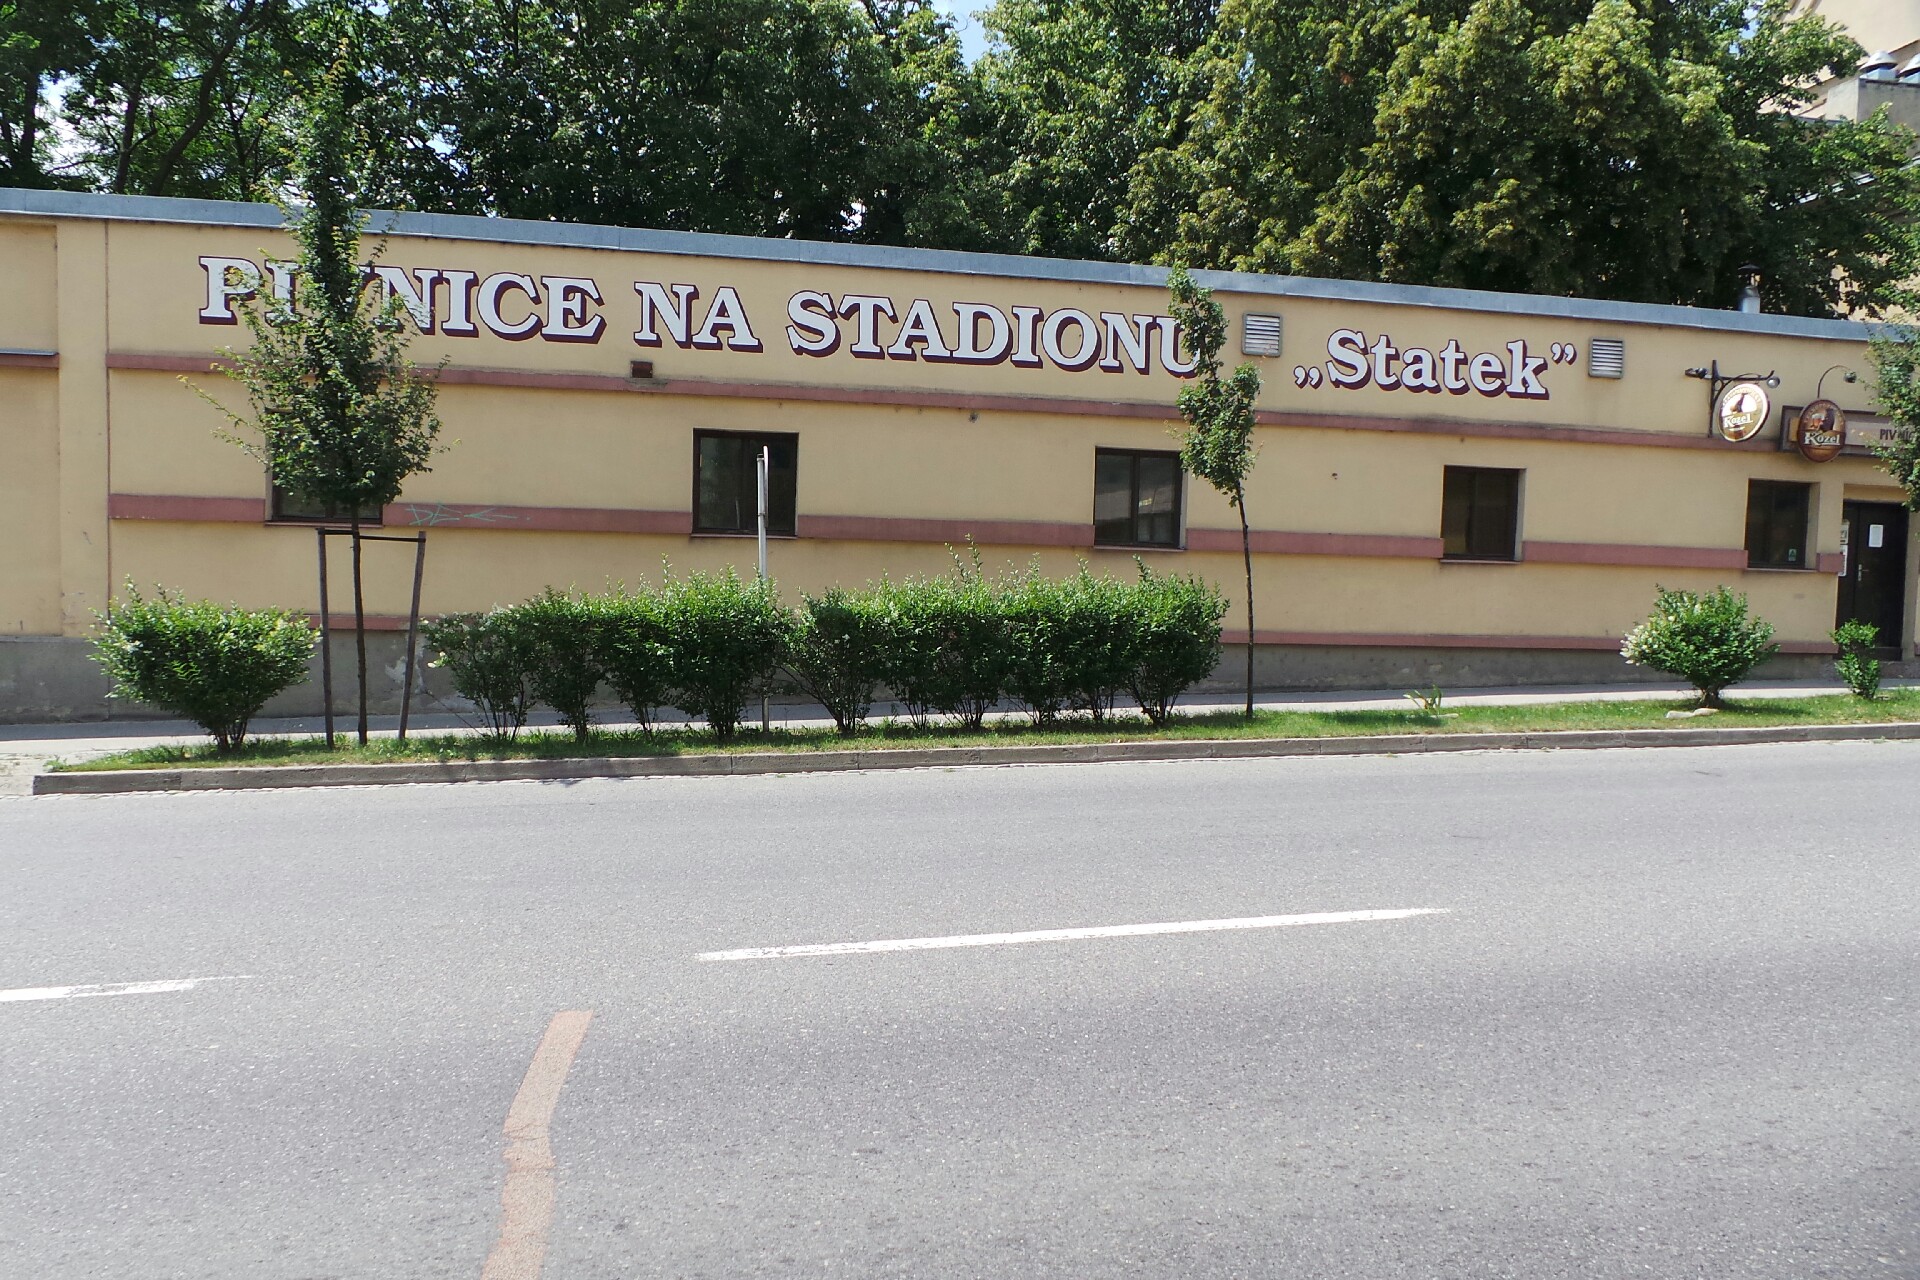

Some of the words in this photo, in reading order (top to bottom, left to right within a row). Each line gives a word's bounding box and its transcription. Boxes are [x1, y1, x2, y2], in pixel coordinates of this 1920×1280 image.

[198, 254, 607, 344] PINICE
[633, 281, 763, 353] NA
[786, 290, 1202, 379] STADIONU
[1723, 413, 1754, 428] Kozel
[1804, 431, 1841, 446] Kozel
